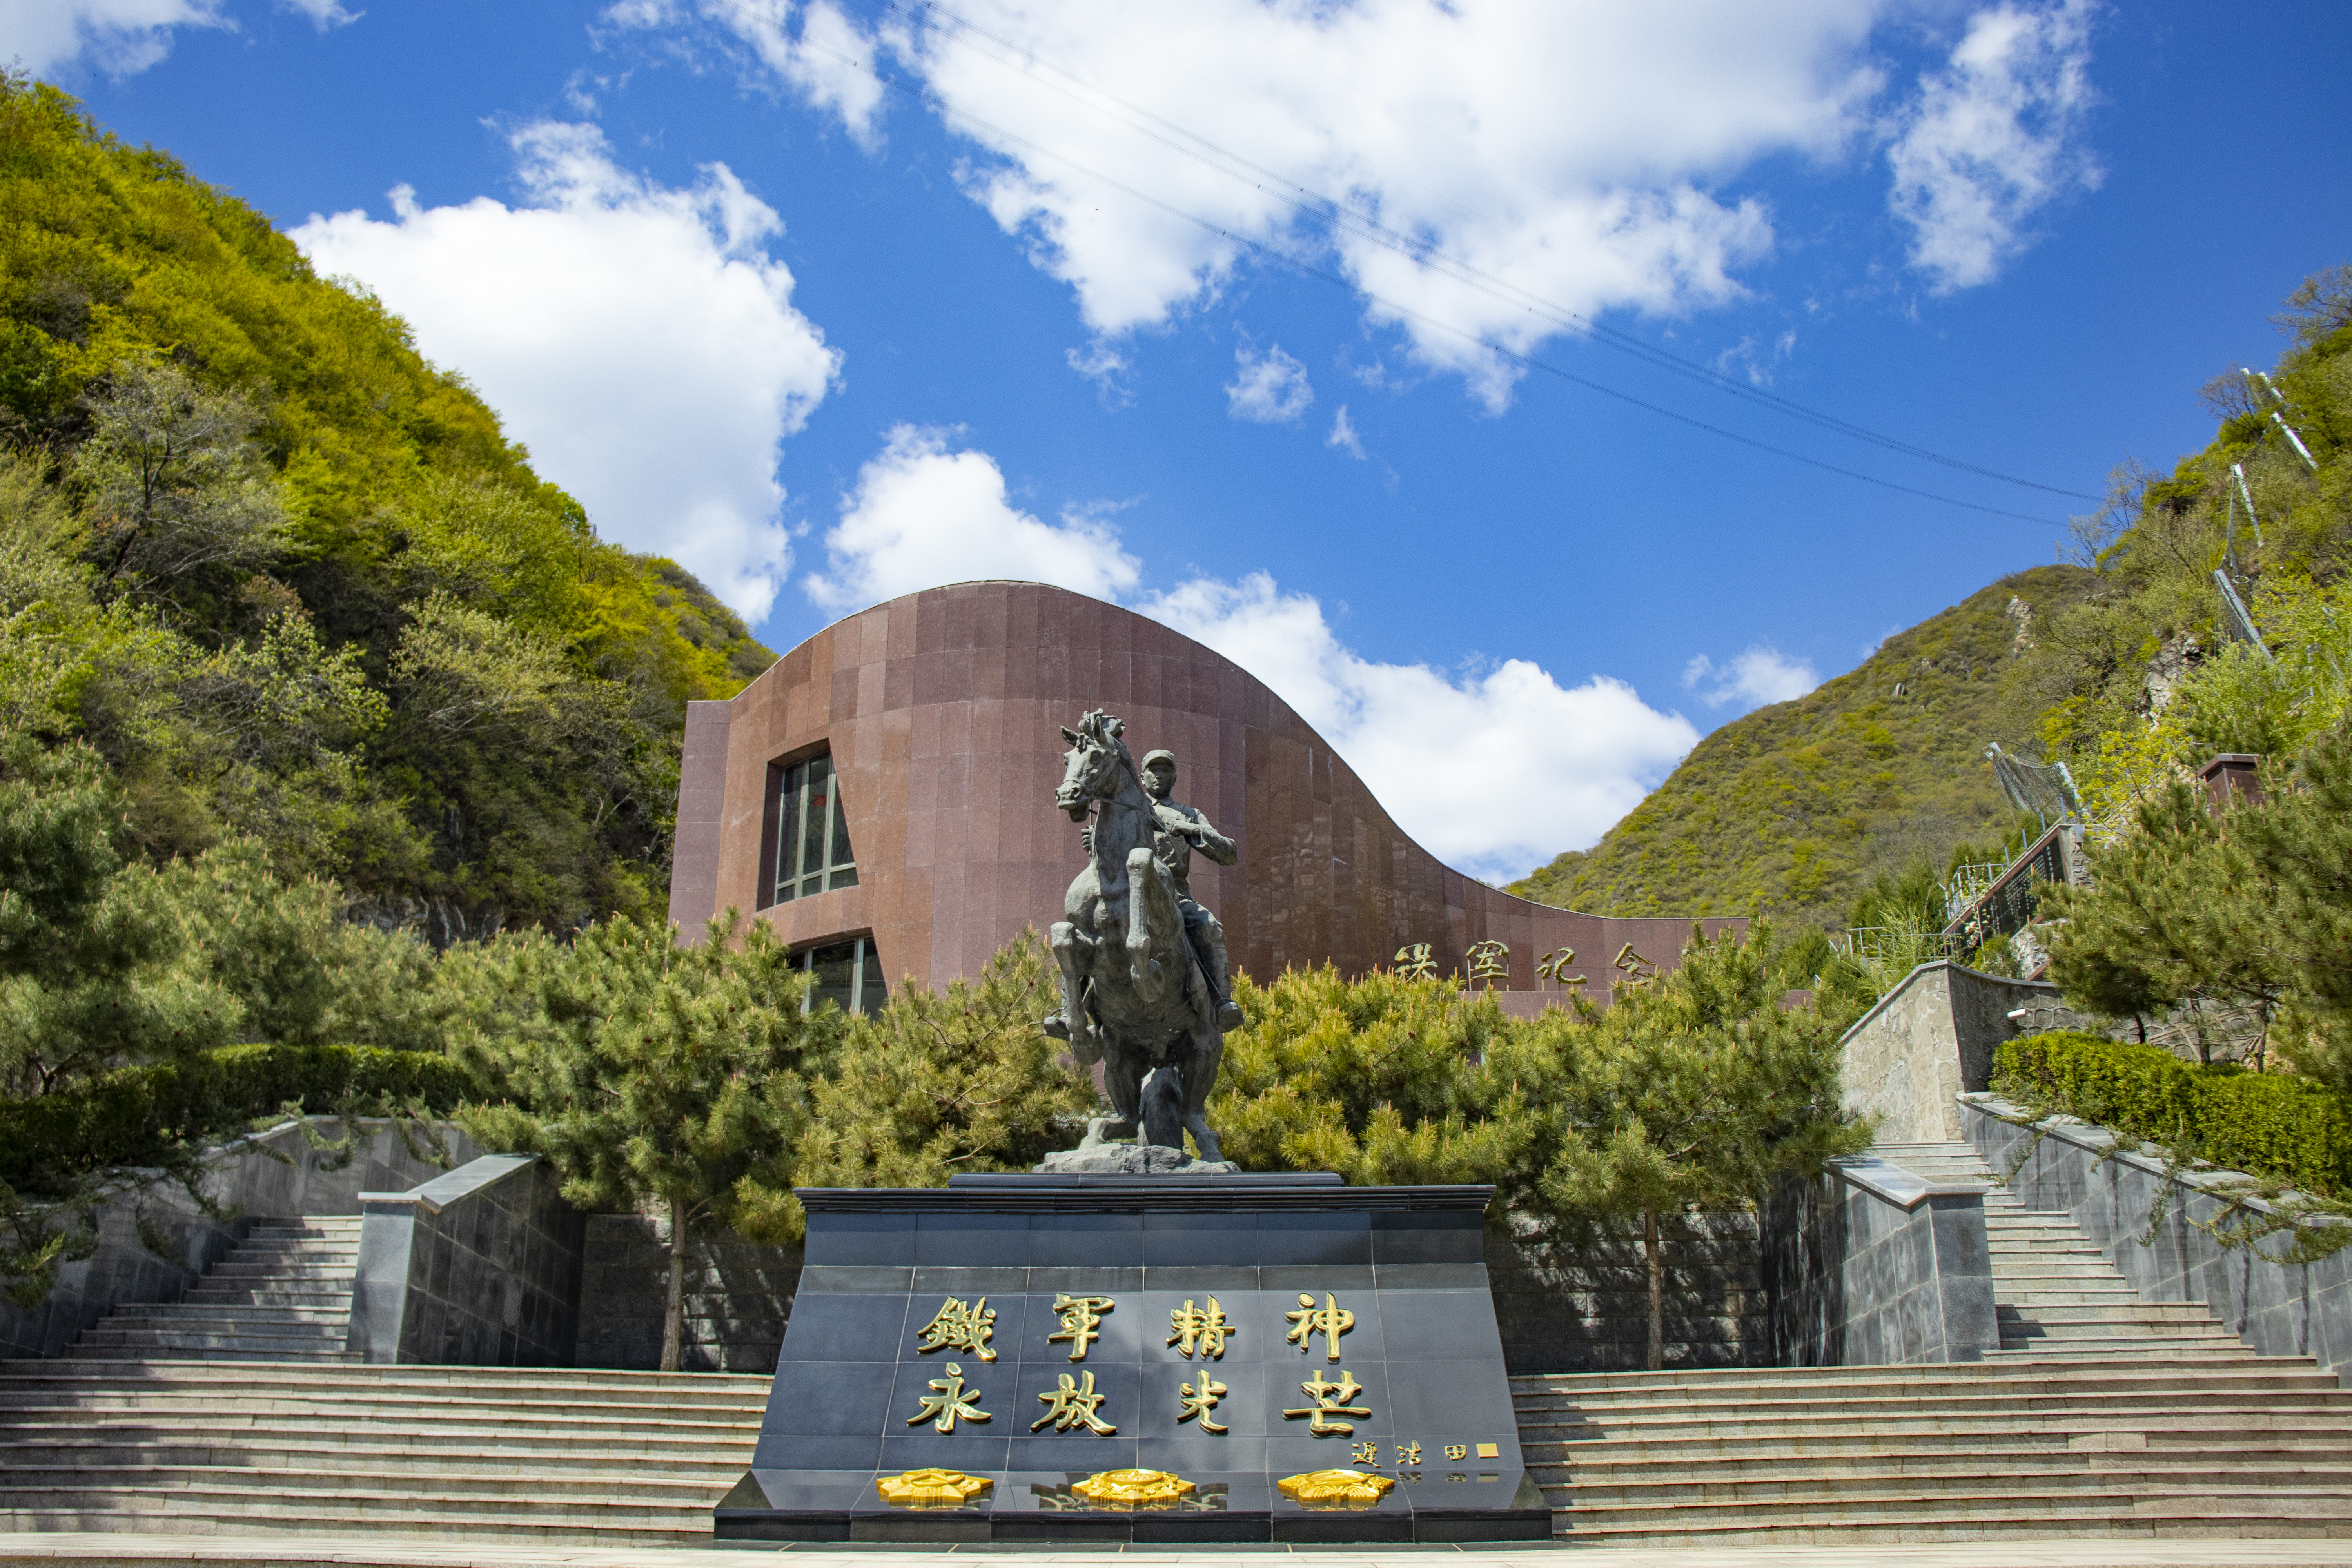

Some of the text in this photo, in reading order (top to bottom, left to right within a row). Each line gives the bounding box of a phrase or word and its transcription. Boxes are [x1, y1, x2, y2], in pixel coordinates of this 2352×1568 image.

[1394, 940, 1720, 985] 铁军纪念
[917, 1292, 1355, 1363] 鐵軍精神
[907, 1362, 1372, 1437] 永放光芒
